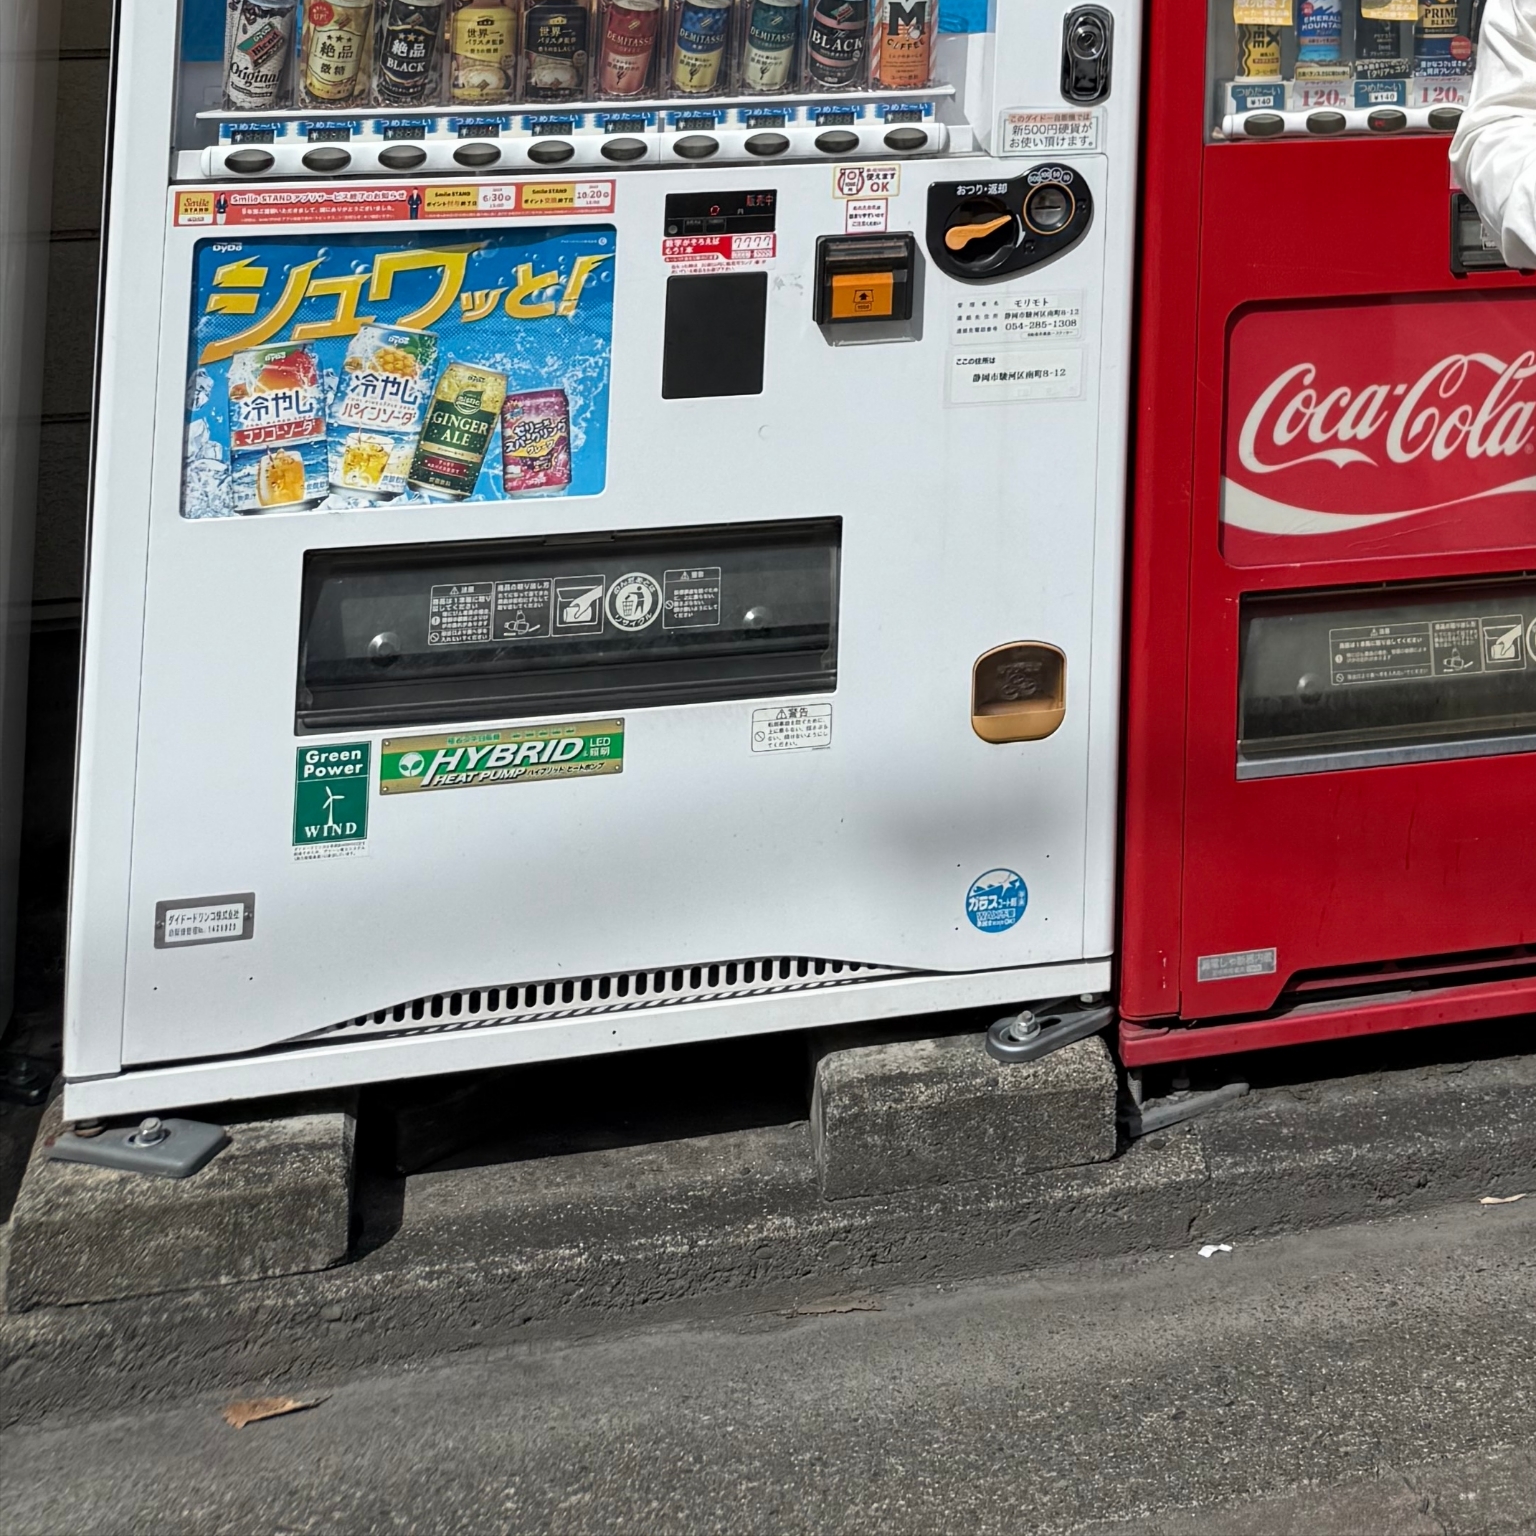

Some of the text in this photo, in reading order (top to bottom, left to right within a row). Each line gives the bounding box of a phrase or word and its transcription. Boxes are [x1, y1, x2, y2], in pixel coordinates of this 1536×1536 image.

[888, 1, 926, 37] M
[679, 30, 725, 45] DEMITASSE
[750, 26, 796, 42] DEMITASSE
[811, 30, 863, 52] BLACK
[319, 41, 354, 59] 絶品
[391, 39, 426, 58] 絶品
[320, 63, 346, 76] 微糖
[386, 57, 425, 72] BLACK
[1236, 87, 1281, 97] つめた〜い
[1358, 83, 1402, 93] つめた〜い
[1421, 87, 1464, 103] 120円
[1250, 97, 1271, 106] ¥140
[1302, 90, 1346, 106] 120円
[1374, 93, 1395, 102] ¥140
[1012, 121, 1093, 136] 新500円硬貨が
[1009, 136, 1094, 149] お使い頂けます。
[866, 172, 896, 181] 使えます
[870, 182, 890, 193] OK
[956, 183, 1008, 196] おつり・返却
[212, 242, 243, 253] DyDo
[200, 242, 617, 364] シュワッと!
[1014, 297, 1049, 308] モリモト
[1004, 319, 1078, 331] 054-285-1308
[956, 357, 996, 366] ここの住所は
[350, 373, 419, 404] 冷やし
[243, 391, 314, 421] 冷やし
[341, 404, 417, 426] パインソーダ
[433, 411, 489, 435] GINGER
[243, 418, 317, 444] マンゴーソーダ
[441, 428, 472, 446] ALE
[504, 421, 567, 454] スパークリング
[590, 737, 611, 747] LED
[305, 749, 362, 764] Green
[420, 737, 585, 788] HYBRID
[303, 763, 364, 778] Power
[432, 768, 527, 787] HEAT PUMP
[304, 822, 357, 839] WIND
[968, 895, 998, 912] ガラス
